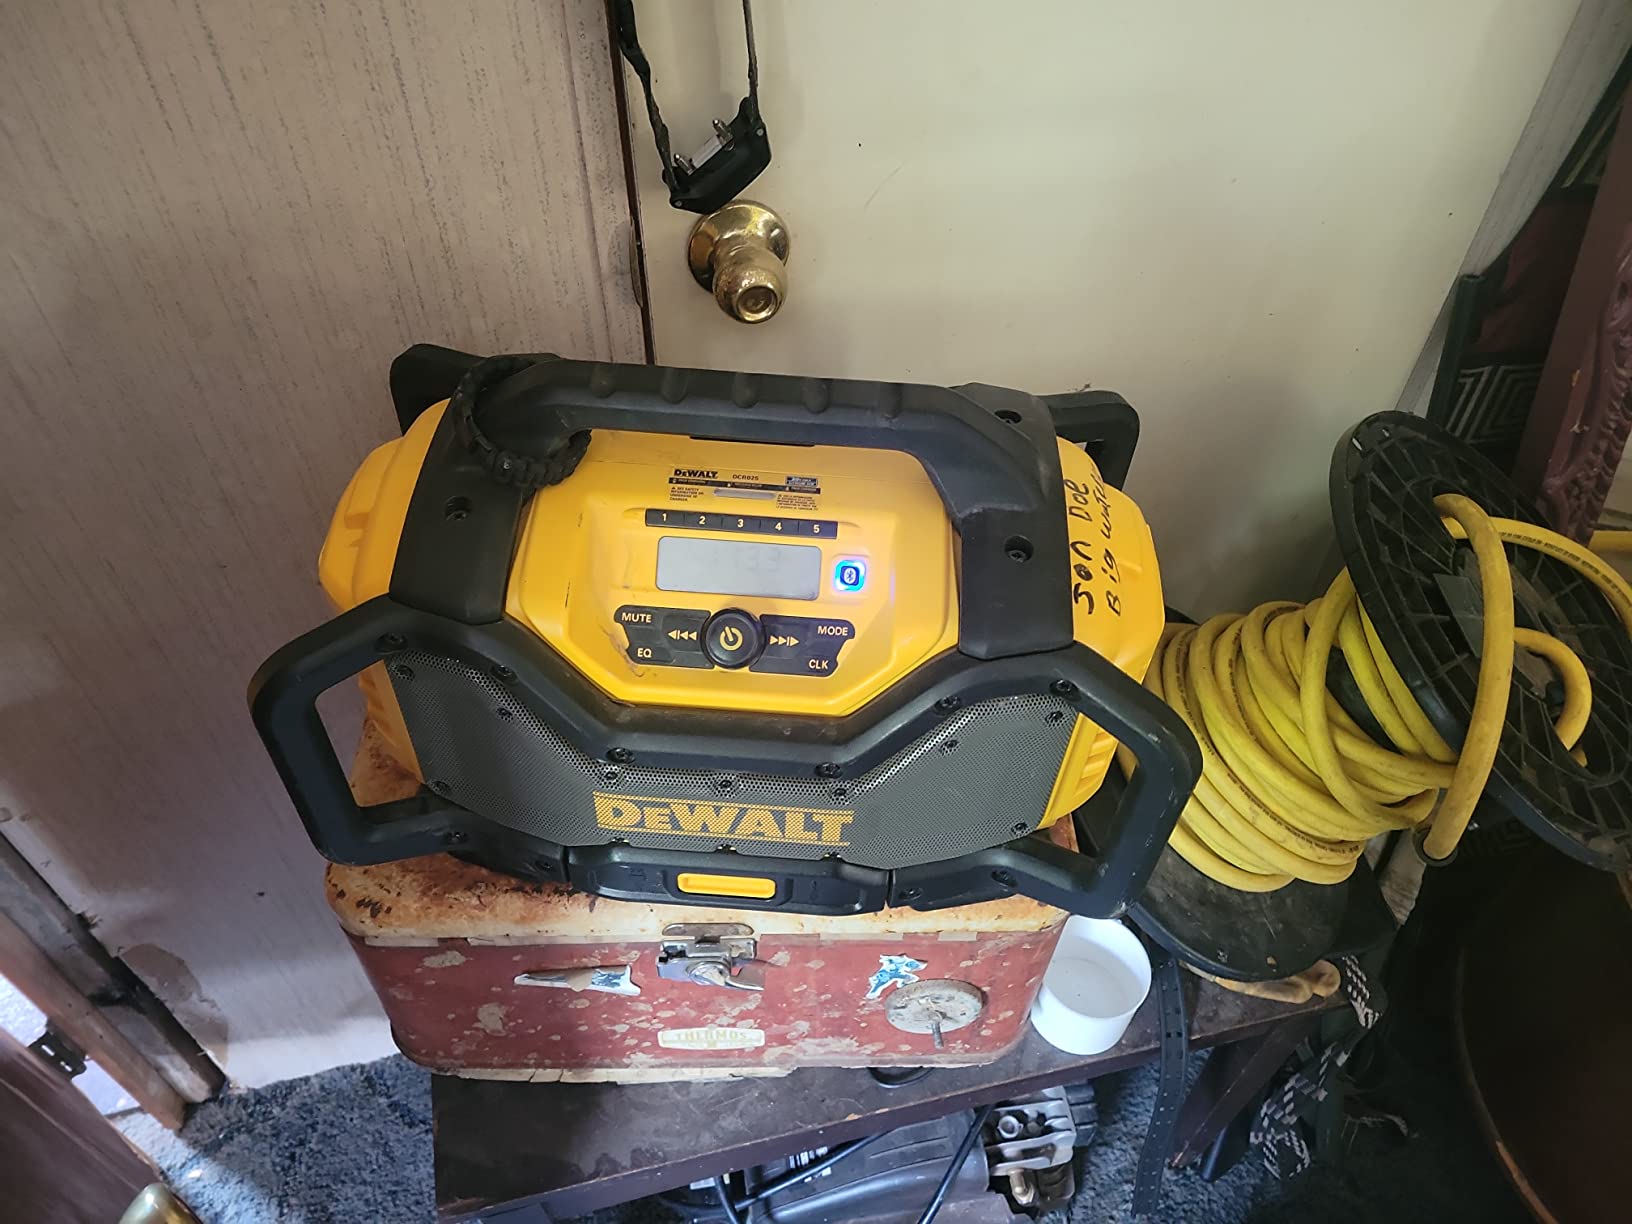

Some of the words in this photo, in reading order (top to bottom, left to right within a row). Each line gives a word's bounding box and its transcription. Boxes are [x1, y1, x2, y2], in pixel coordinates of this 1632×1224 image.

[662, 513, 667, 521] 1
[699, 516, 706, 525] 2
[737, 519, 744, 528] 3
[775, 522, 782, 531] 4
[813, 524, 820, 533] 5
[621, 612, 652, 623] MUTE
[817, 625, 848, 636] MODE
[637, 648, 652, 658] EQ
[808, 659, 829, 670] CLK
